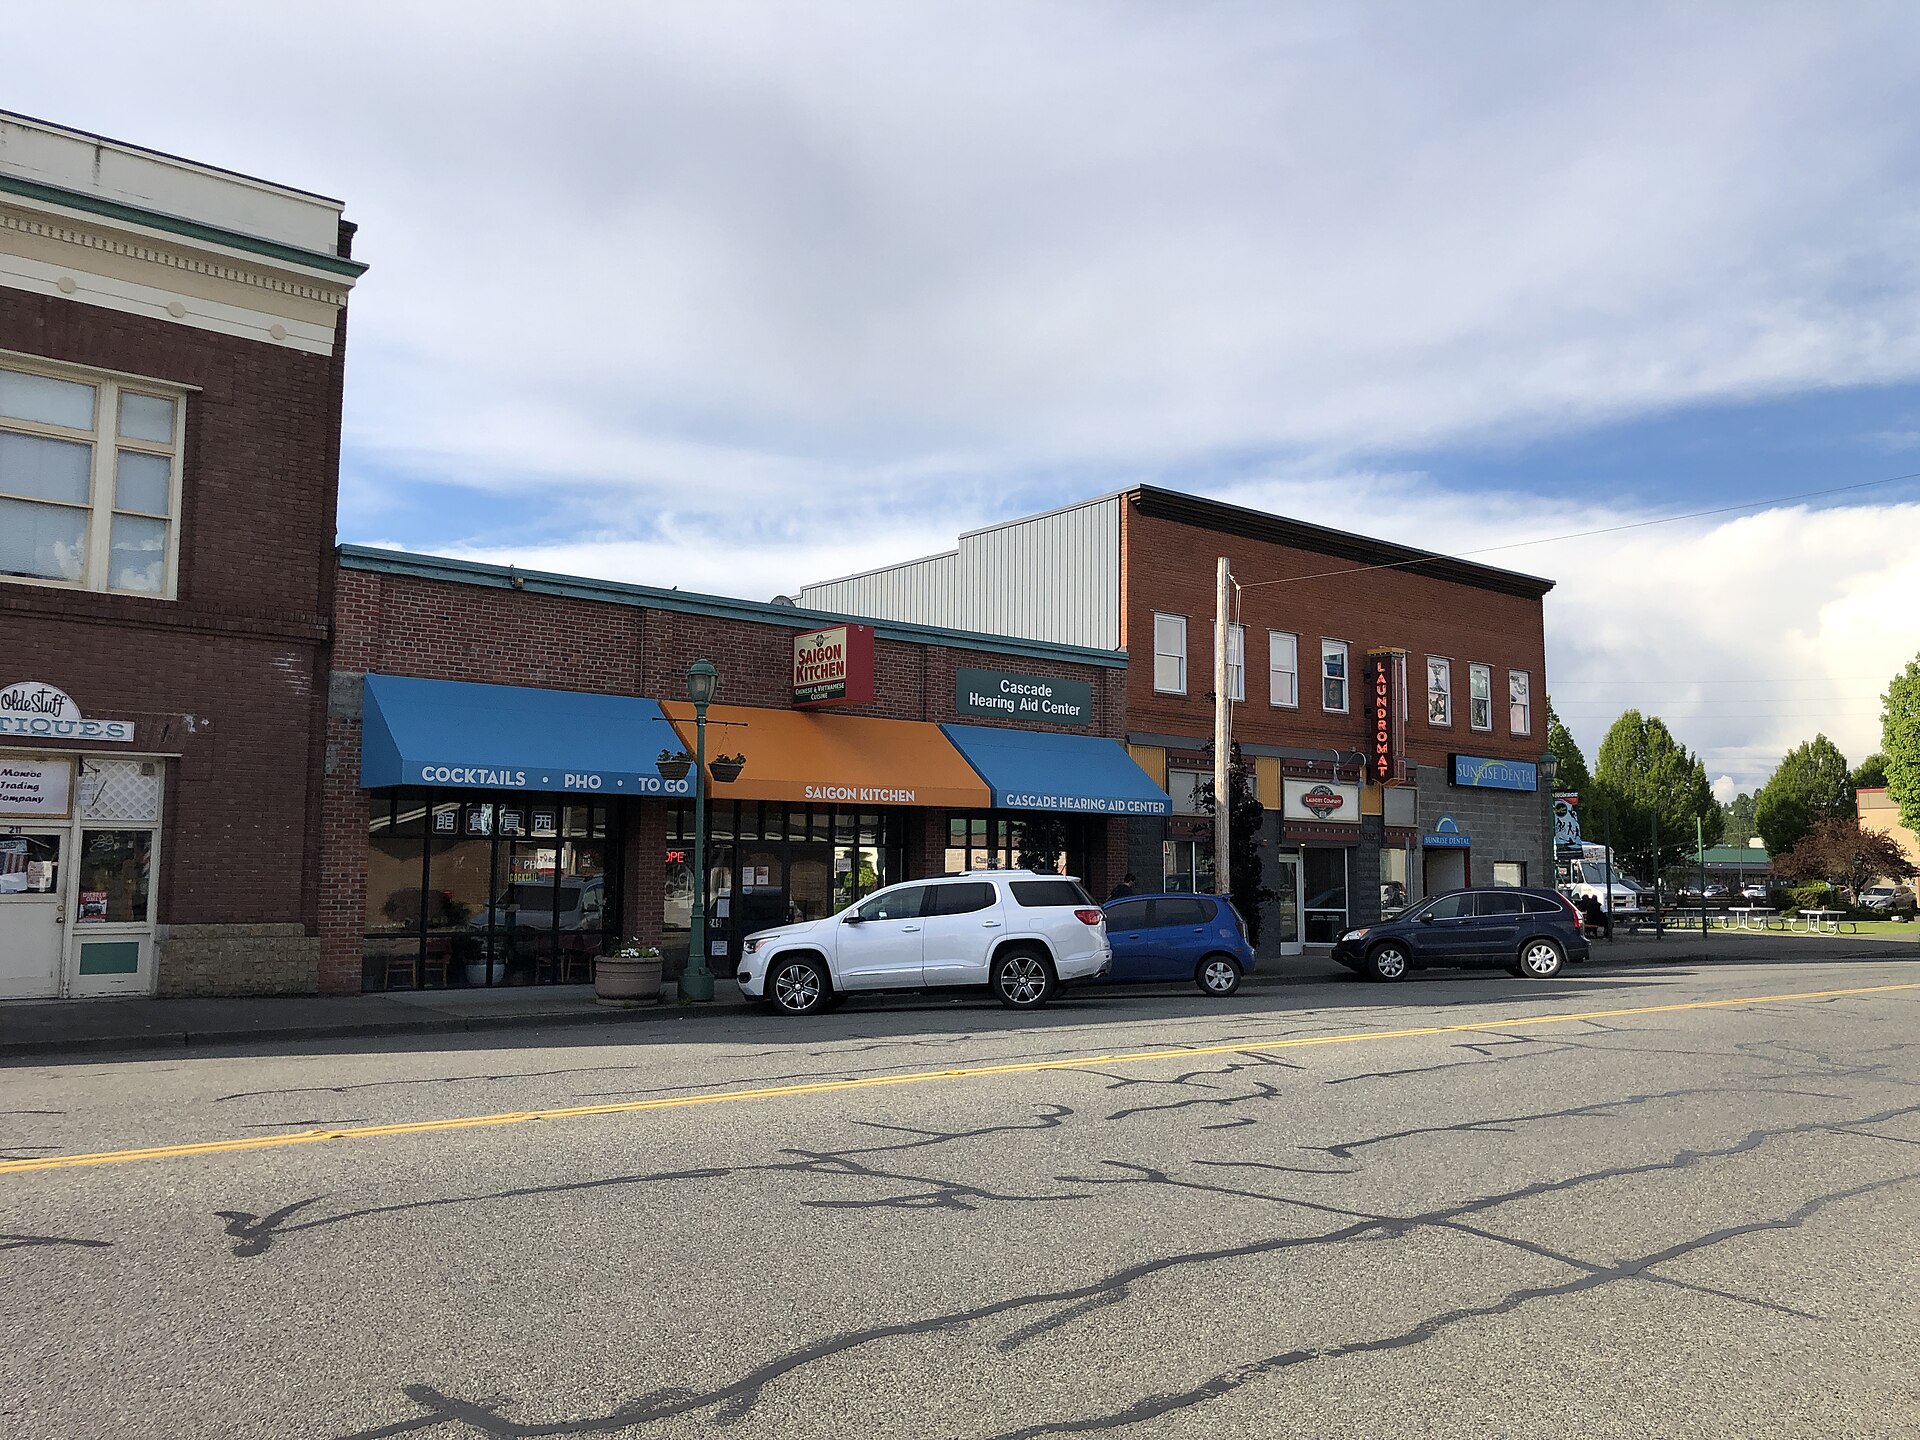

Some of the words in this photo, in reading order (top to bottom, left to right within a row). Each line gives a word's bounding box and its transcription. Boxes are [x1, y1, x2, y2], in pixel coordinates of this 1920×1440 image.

[798, 643, 842, 666] SAIGON
[796, 660, 845, 683] KITCHEN
[813, 686, 818, 694] &
[1000, 679, 1053, 697] Cascade
[1, 689, 31, 711] Olde
[31, 688, 67, 717] Stuff
[969, 692, 1015, 713] Hearing
[1020, 697, 1038, 712] Aid
[1041, 699, 1081, 716] Center
[1376, 661, 1388, 777] LAUNDROMAT
[0, 768, 42, 778] Monroe
[421, 766, 526, 786] COCKTAILS
[564, 773, 602, 789] PHO
[638, 777, 661, 792] TO
[664, 779, 689, 793] GO
[1456, 763, 1499, 780] SUNRISE
[1501, 767, 1536, 784] DENTAL
[0, 781, 40, 792] Trading
[804, 785, 857, 800] SAIGON
[860, 788, 915, 802] KITCHEN
[1006, 793, 1057, 808] CASCADE
[1059, 796, 1106, 810] HEARING
[1108, 799, 1126, 812] AID
[1127, 801, 1165, 813] CENTER
[9, 826, 22, 834] 211
[1425, 836, 1448, 845] SUNRISE
[1448, 836, 1470, 845] DENTAL
